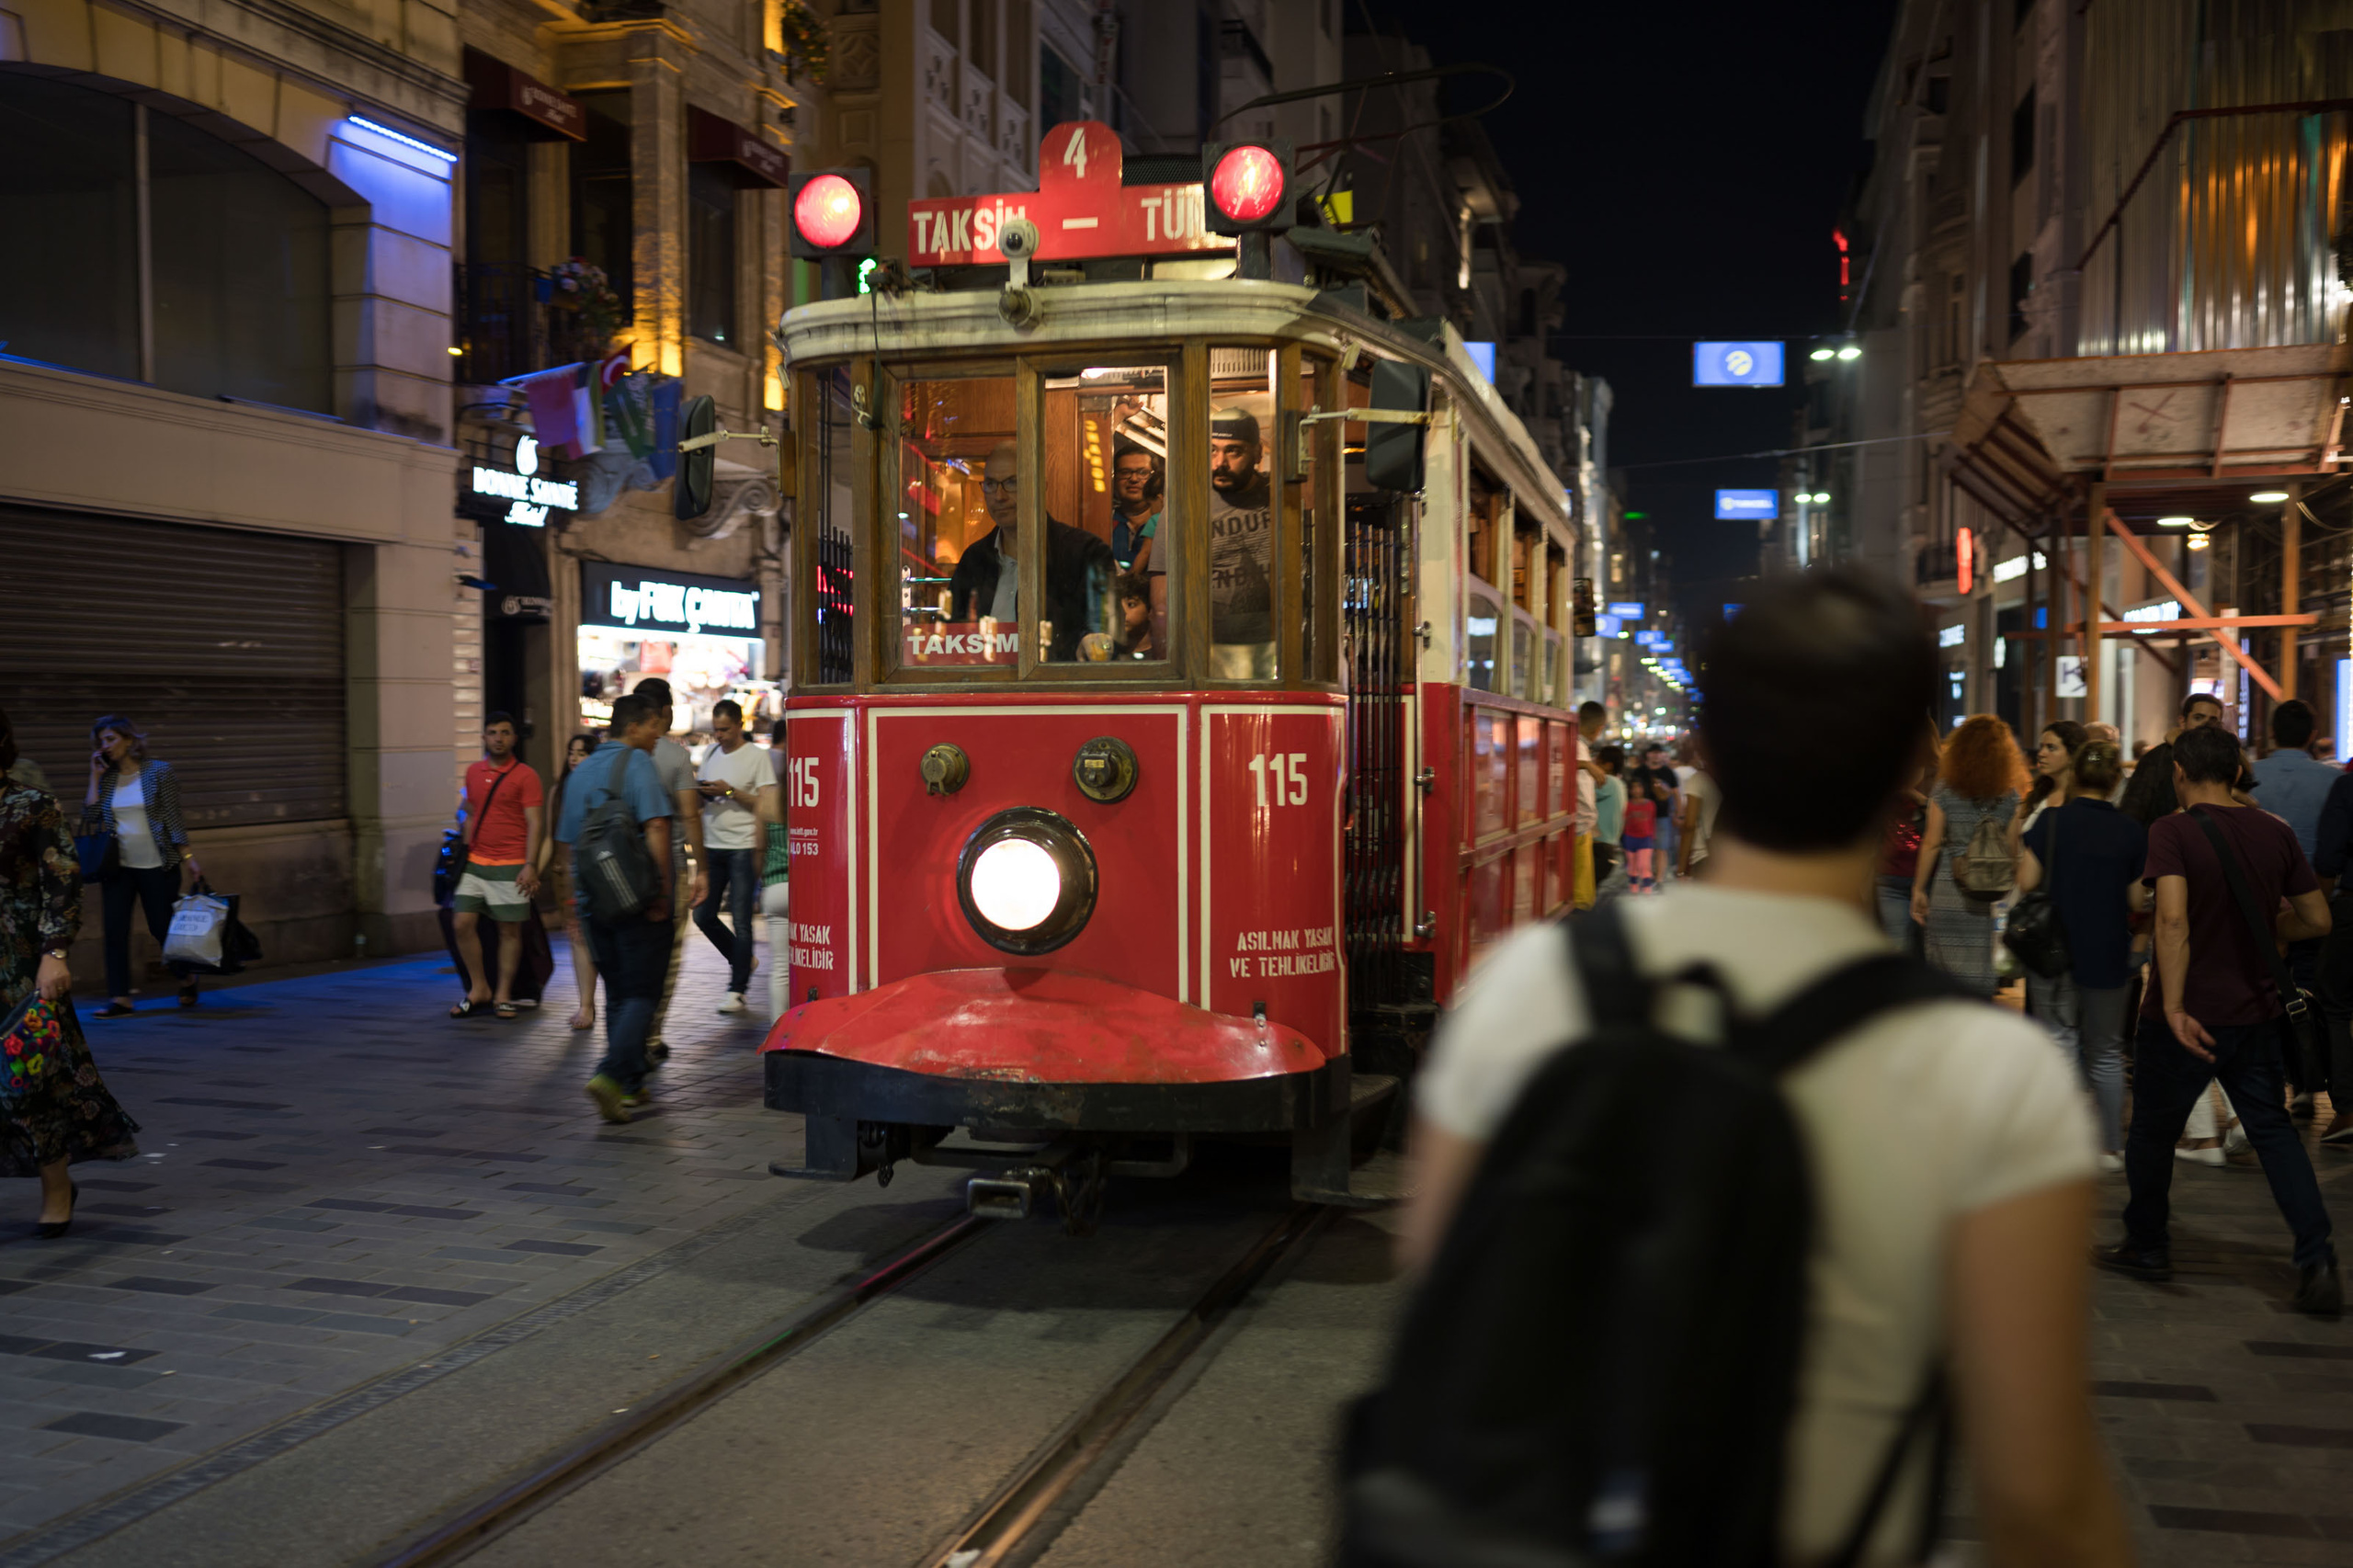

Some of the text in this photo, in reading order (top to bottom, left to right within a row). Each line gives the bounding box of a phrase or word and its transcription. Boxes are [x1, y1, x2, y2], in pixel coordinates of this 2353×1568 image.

[1063, 127, 1087, 179] 4
[789, 756, 820, 807] 115
[1248, 753, 1308, 807] 115
[802, 842, 819, 856] 153
[800, 923, 831, 945] YASAK
[1303, 926, 1334, 949] YASAK
[1230, 957, 1251, 978] VE
